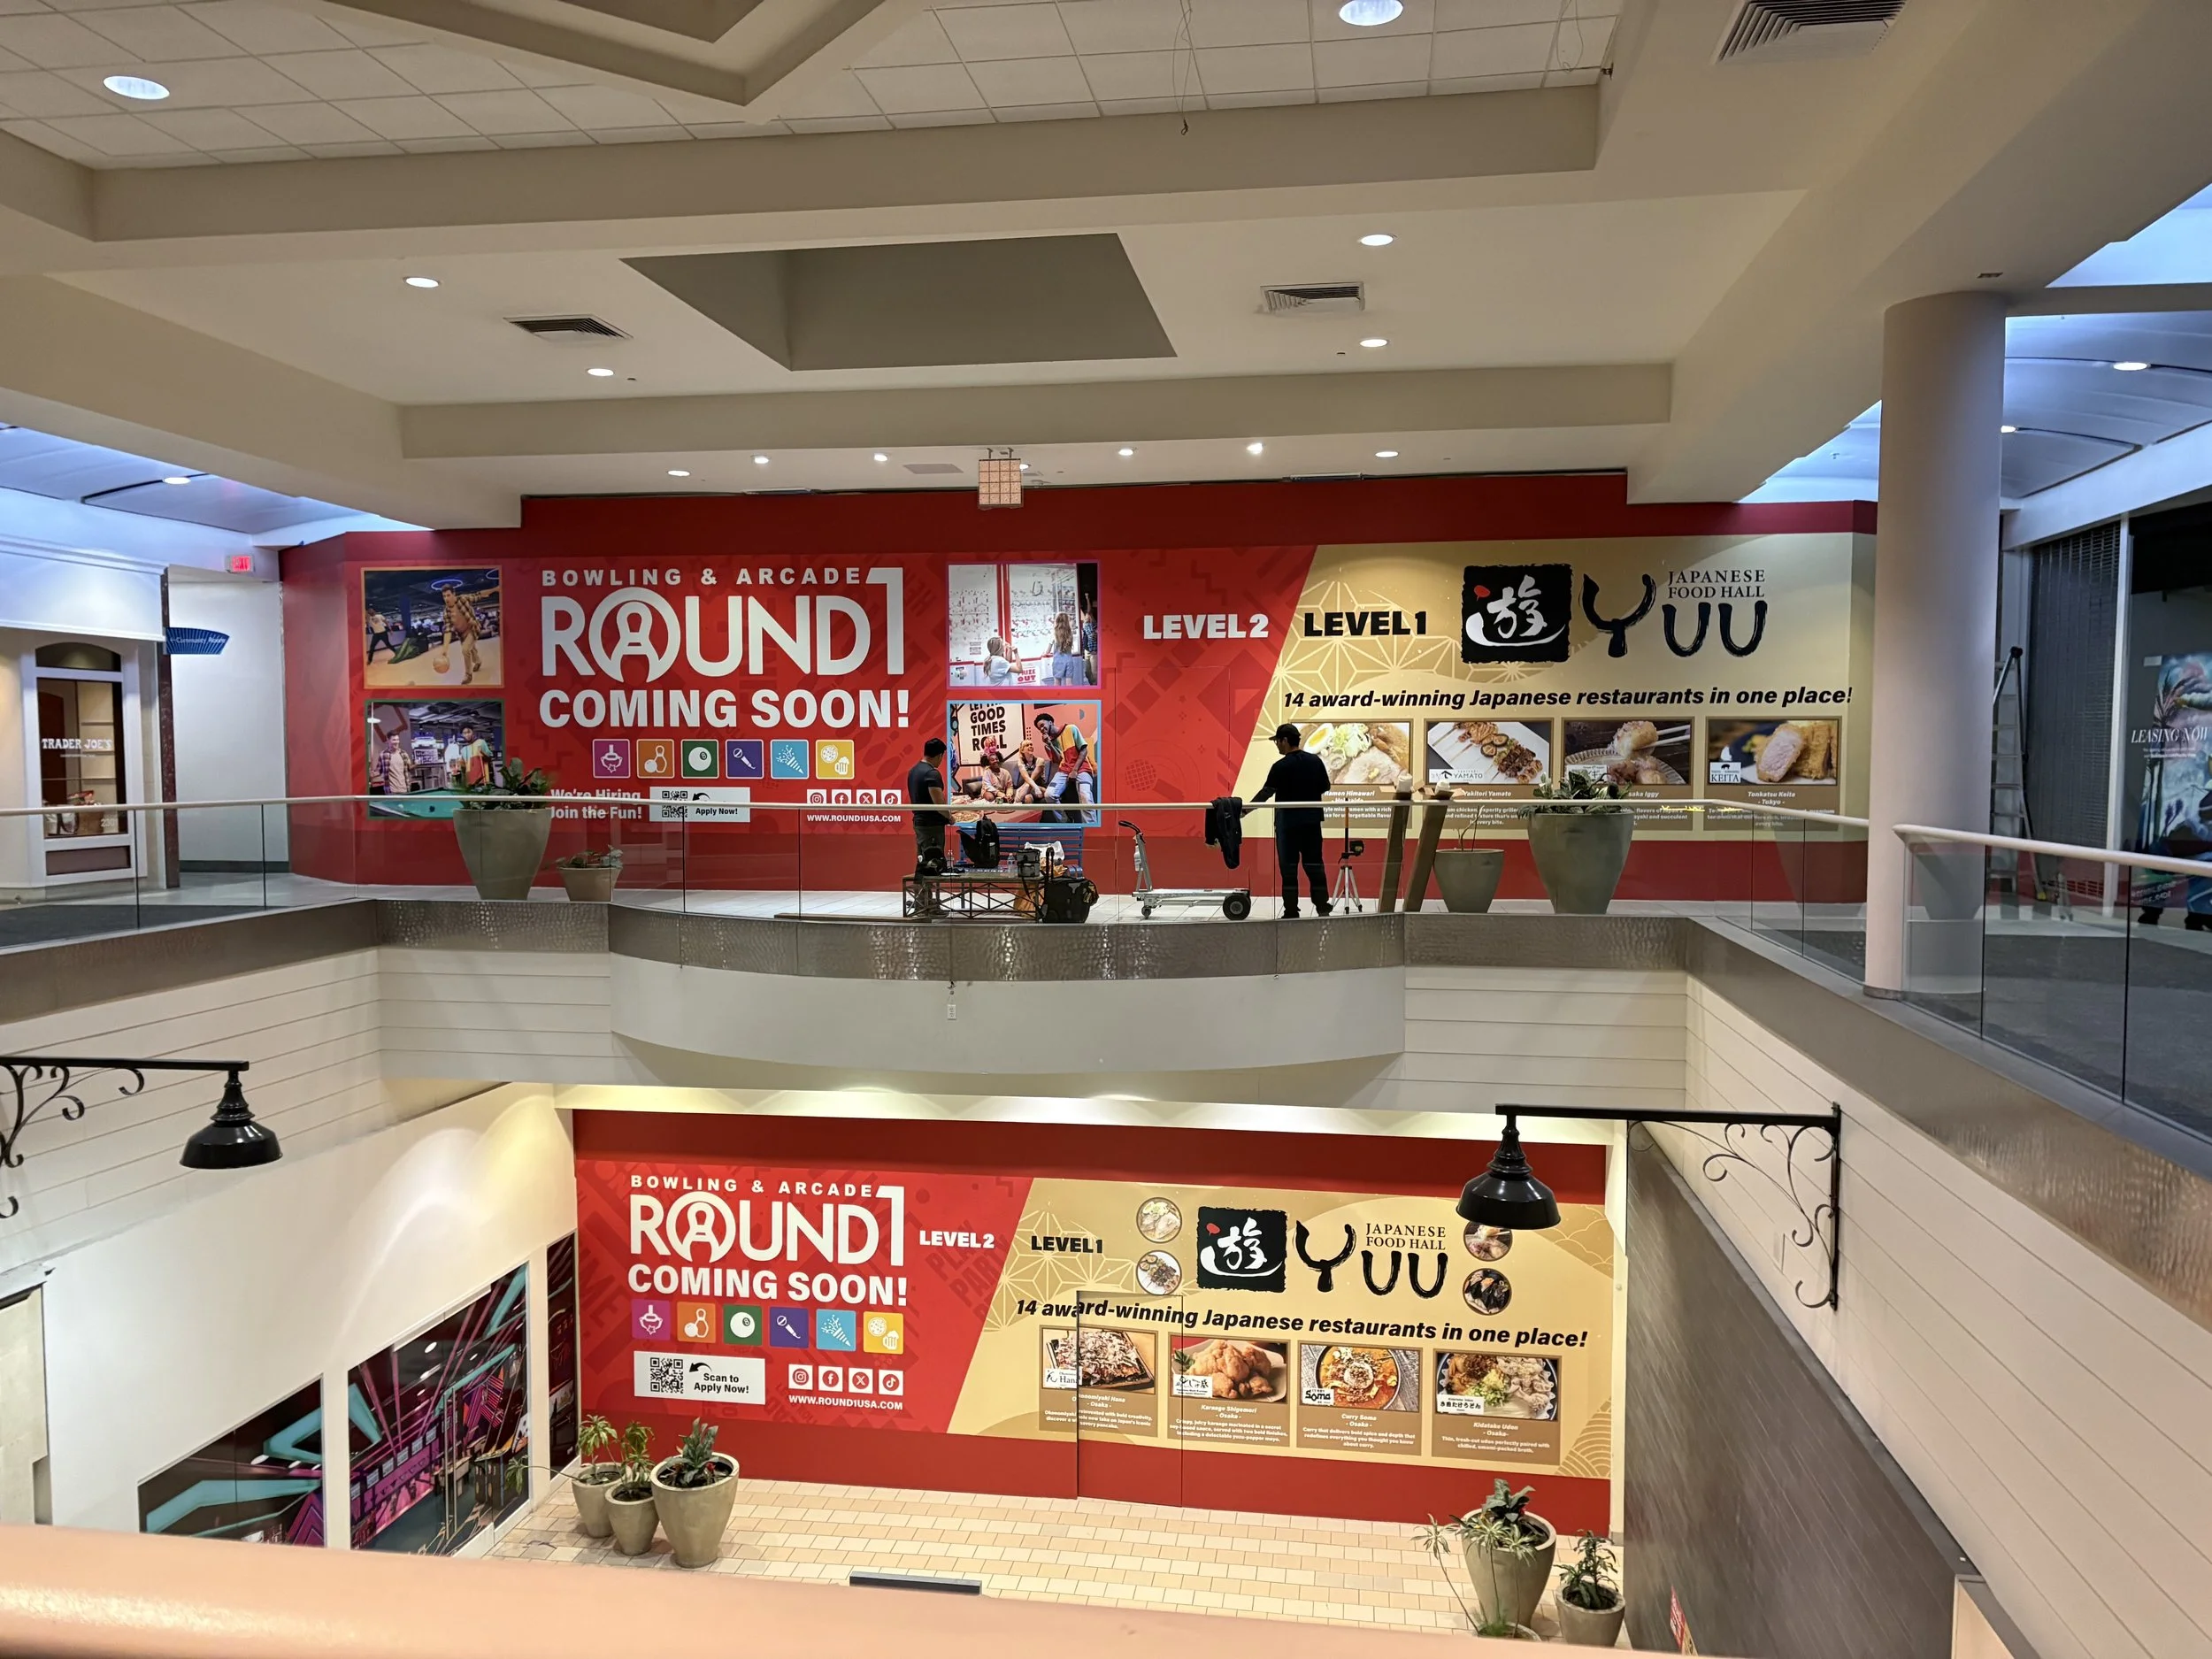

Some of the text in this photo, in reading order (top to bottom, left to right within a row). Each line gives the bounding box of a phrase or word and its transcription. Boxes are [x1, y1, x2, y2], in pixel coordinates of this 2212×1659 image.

[541, 567, 860, 587] BOWLING & ARCADE
[1668, 569, 1765, 584] JAPANESE
[1668, 584, 1765, 599] FOOD HALL
[1283, 687, 1853, 712] 14 award-winning Japanese restaurants in one place!
[539, 689, 909, 728] COMING SOON!
[970, 707, 1005, 724] GOOD
[971, 720, 1006, 736] TIMES
[2131, 728, 2179, 743] LEASING
[42, 738, 113, 749] TRADER JOE'S
[972, 734, 1007, 751] ROL
[550, 805, 641, 819] Join the Fun!
[631, 1175, 872, 1197] BOWLING & ARCADE
[1366, 1223, 1446, 1238] JAPANESE
[1366, 1236, 1446, 1250] FOOD HALL
[628, 1264, 777, 1299] COMING
[787, 1272, 907, 1306] SOON!
[1017, 1300, 1588, 1350] 14 award-winning Japanese restaurants in one place!
[703, 1372, 740, 1383] Scan to
[694, 1382, 749, 1394] Apply Now!
[789, 1395, 902, 1409] WWW.ROUND1USA.COM
[1305, 1390, 1331, 1402] Soma
